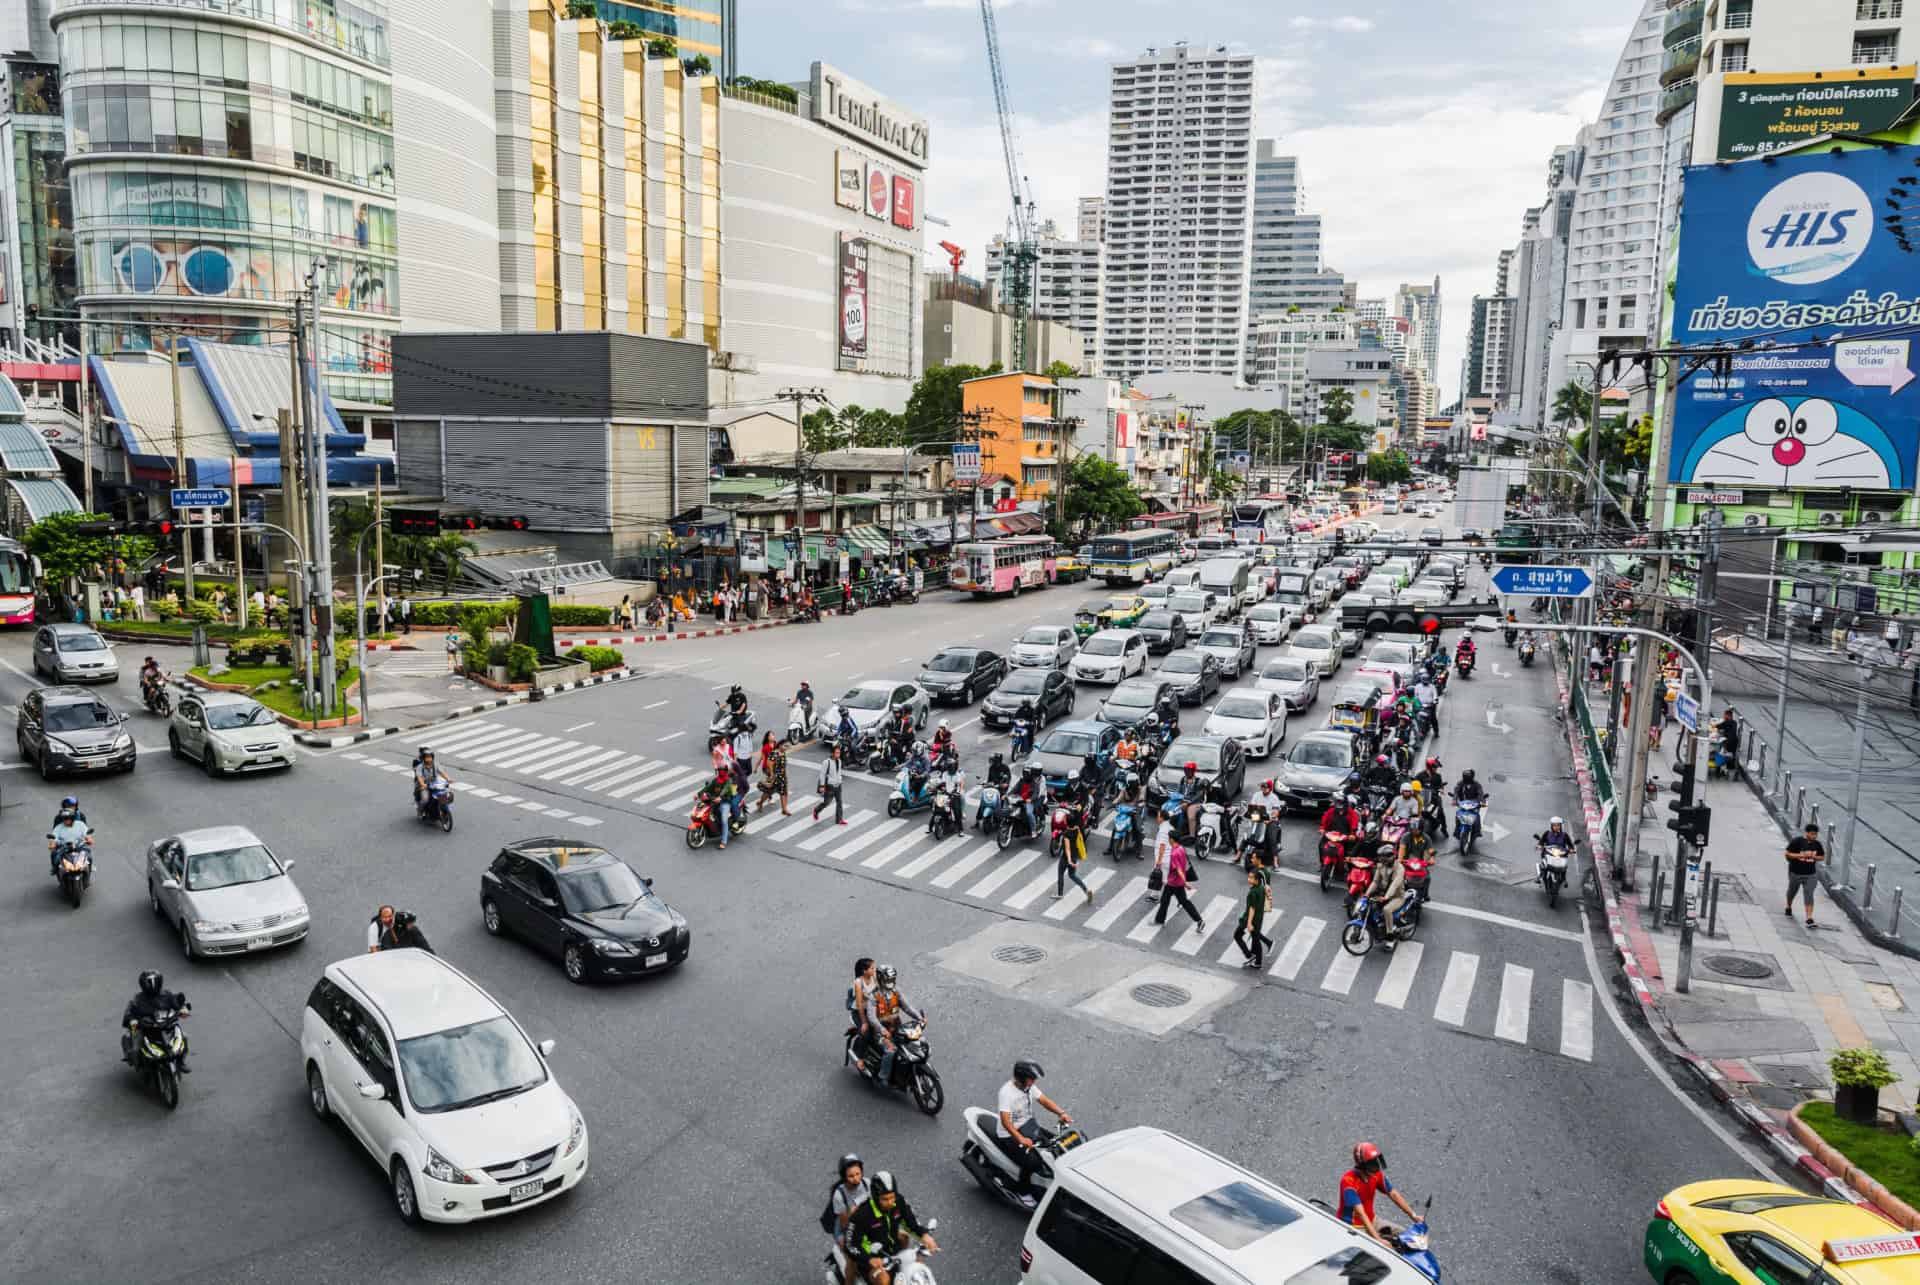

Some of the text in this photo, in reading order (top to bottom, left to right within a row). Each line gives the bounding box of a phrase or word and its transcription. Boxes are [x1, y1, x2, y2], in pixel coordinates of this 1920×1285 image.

[1737, 91, 1747, 103] 3
[1796, 86, 1900, 101] ก่อนปิดโครงการ
[1783, 105, 1844, 117] 2 ห้องนอน
[1767, 120, 1860, 136] พร้อมอยู่ วิวสวย
[846, 308, 861, 326] 100
[1528, 569, 1573, 585] สุขุมวิท
[1846, 1239, 1914, 1256] TAXI-METER
